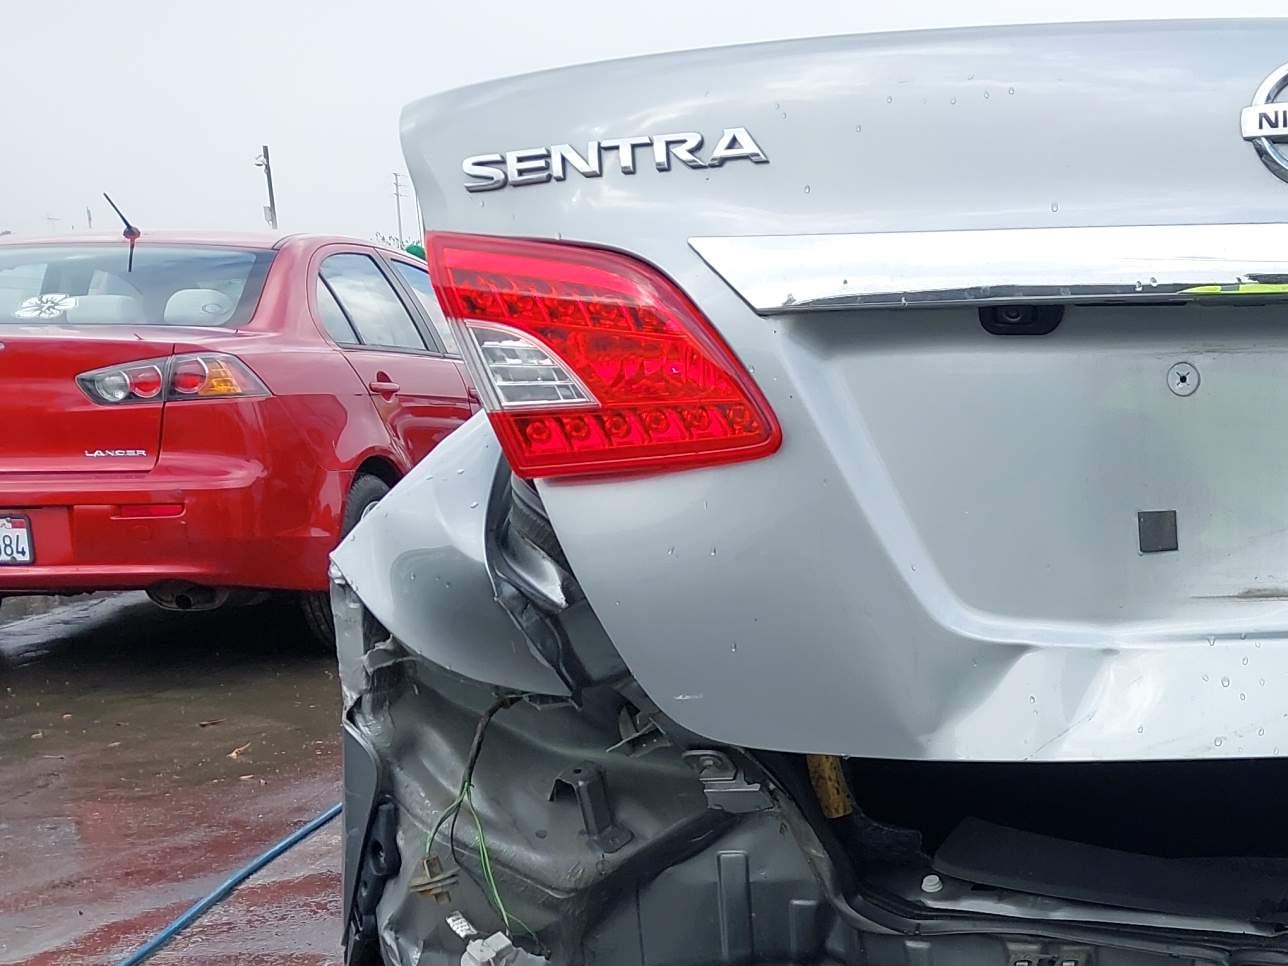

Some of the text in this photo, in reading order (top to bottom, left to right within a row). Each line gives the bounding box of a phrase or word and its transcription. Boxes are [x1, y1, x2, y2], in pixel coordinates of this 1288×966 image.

[462, 127, 769, 192] SENTRA
[84, 449, 147, 458] LANCER
[0, 534, 26, 557] 84
